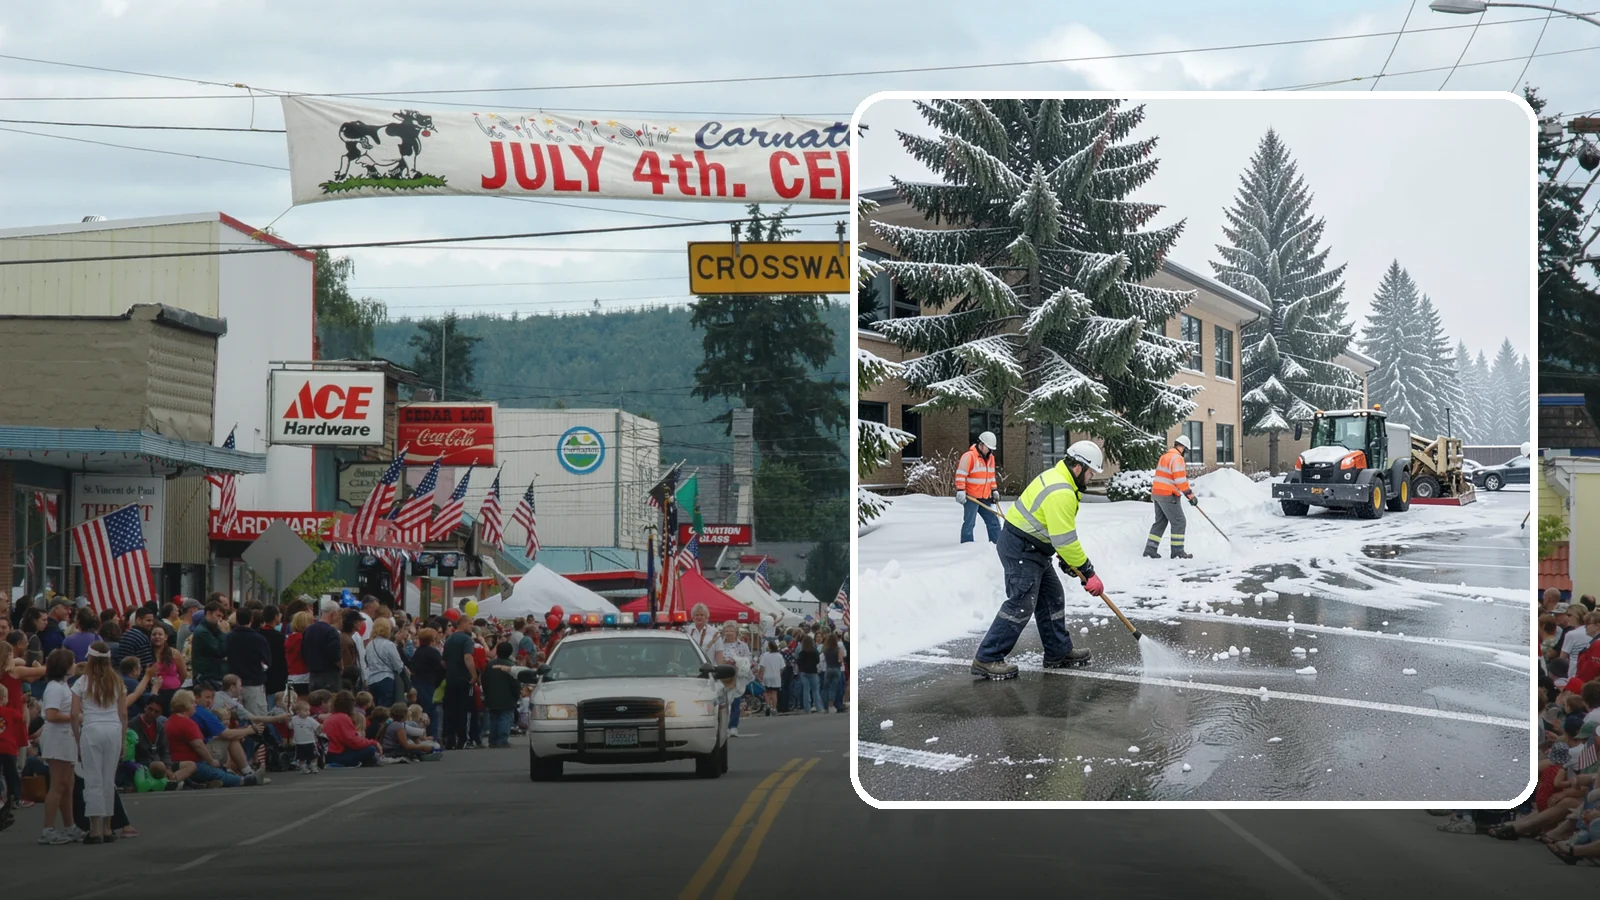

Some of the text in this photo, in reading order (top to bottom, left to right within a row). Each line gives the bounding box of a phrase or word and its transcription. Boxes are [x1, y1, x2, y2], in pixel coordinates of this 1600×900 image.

[481, 141, 604, 192] JULY
[632, 149, 746, 197] 4th.
[697, 254, 850, 279] CROSSWA
[282, 380, 373, 420] ACE
[405, 408, 453, 422] CEDAR
[283, 421, 370, 436] Hardware
[416, 428, 477, 447] Coca-Cola
[353, 467, 386, 481] Simpl
[83, 484, 155, 495] St. Vincent de Paul
[81, 503, 153, 522] THT
[688, 526, 741, 535] CRNATION
[699, 535, 730, 543] GLASS
